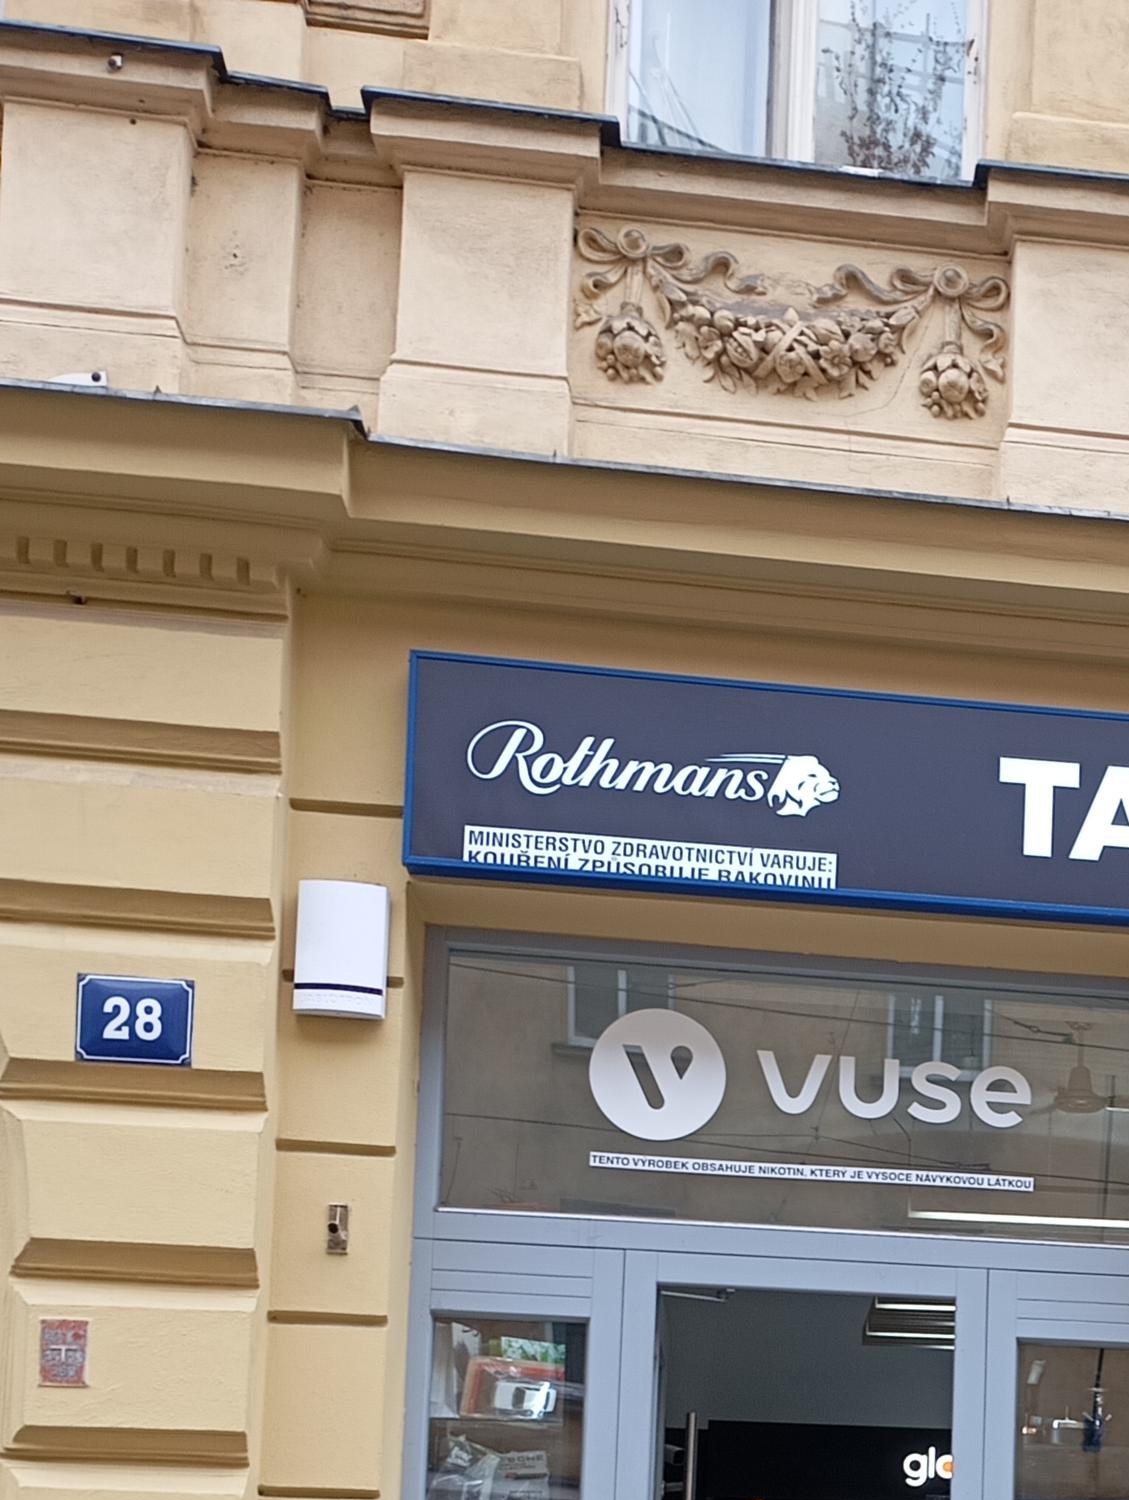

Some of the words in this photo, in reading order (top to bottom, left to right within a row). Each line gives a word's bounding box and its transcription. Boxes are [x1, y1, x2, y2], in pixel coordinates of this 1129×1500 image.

[467, 720, 769, 802] Rothmans
[468, 830, 605, 855] MINISTERSTVO
[611, 841, 755, 867] ZDRAVOTNICTVÍ
[760, 853, 833, 873] VARUJE:
[102, 996, 163, 1041] 28
[591, 1154, 630, 1167] TENTO
[692, 1161, 755, 1174] OBSAHUJE
[850, 1169, 864, 1180] JE
[866, 1171, 912, 1182] VYSOCE
